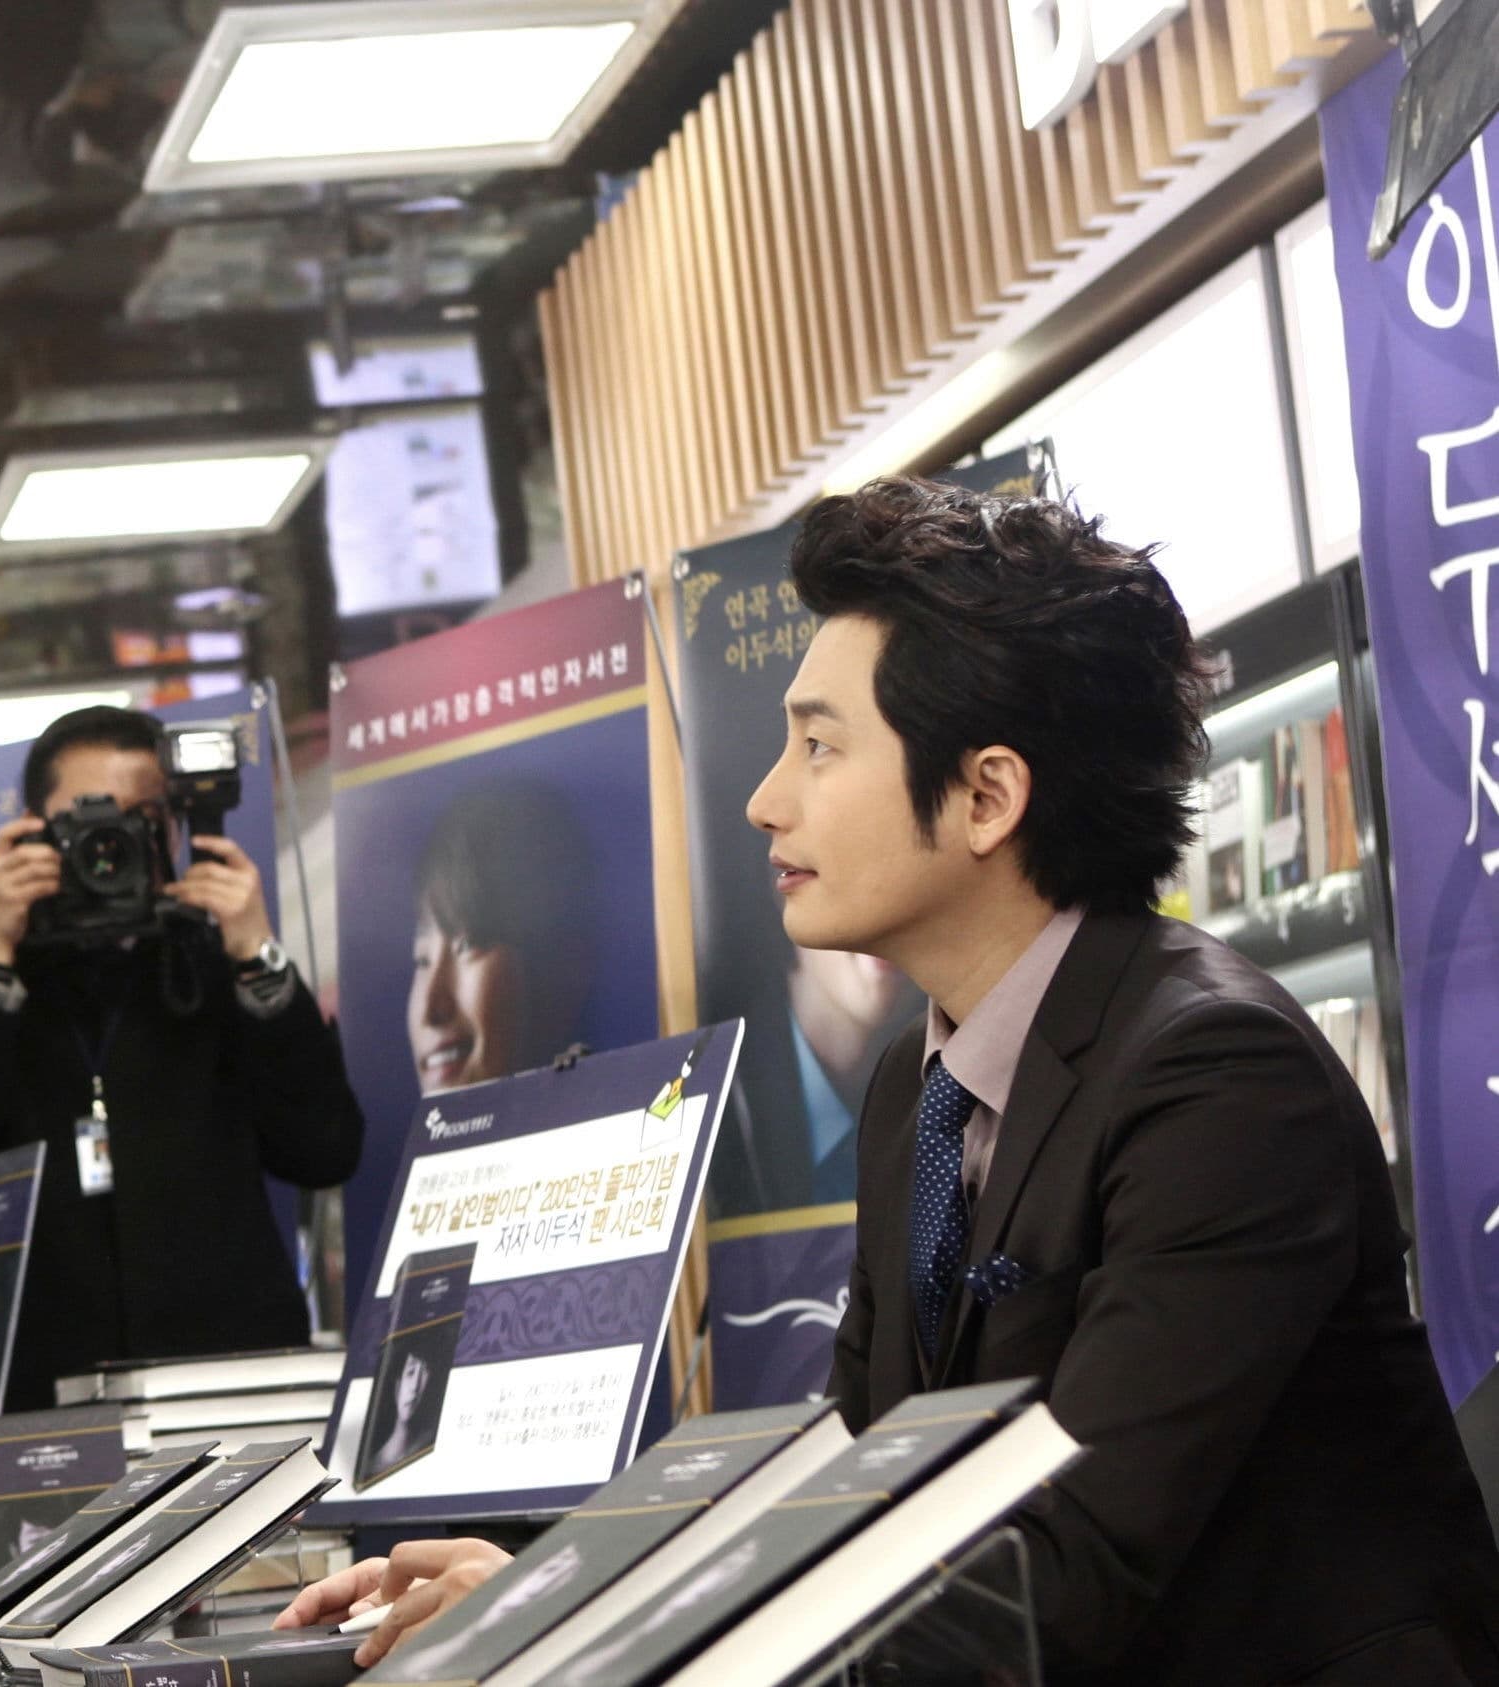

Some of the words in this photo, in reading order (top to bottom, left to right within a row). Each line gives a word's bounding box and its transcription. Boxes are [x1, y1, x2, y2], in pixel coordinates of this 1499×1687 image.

[604, 1152, 680, 1202] 돌파기념
[494, 1221, 532, 1257] 저자
[534, 1210, 587, 1250] 이두석
[589, 1206, 611, 1244] 팬
[610, 1194, 670, 1239] 사인회
